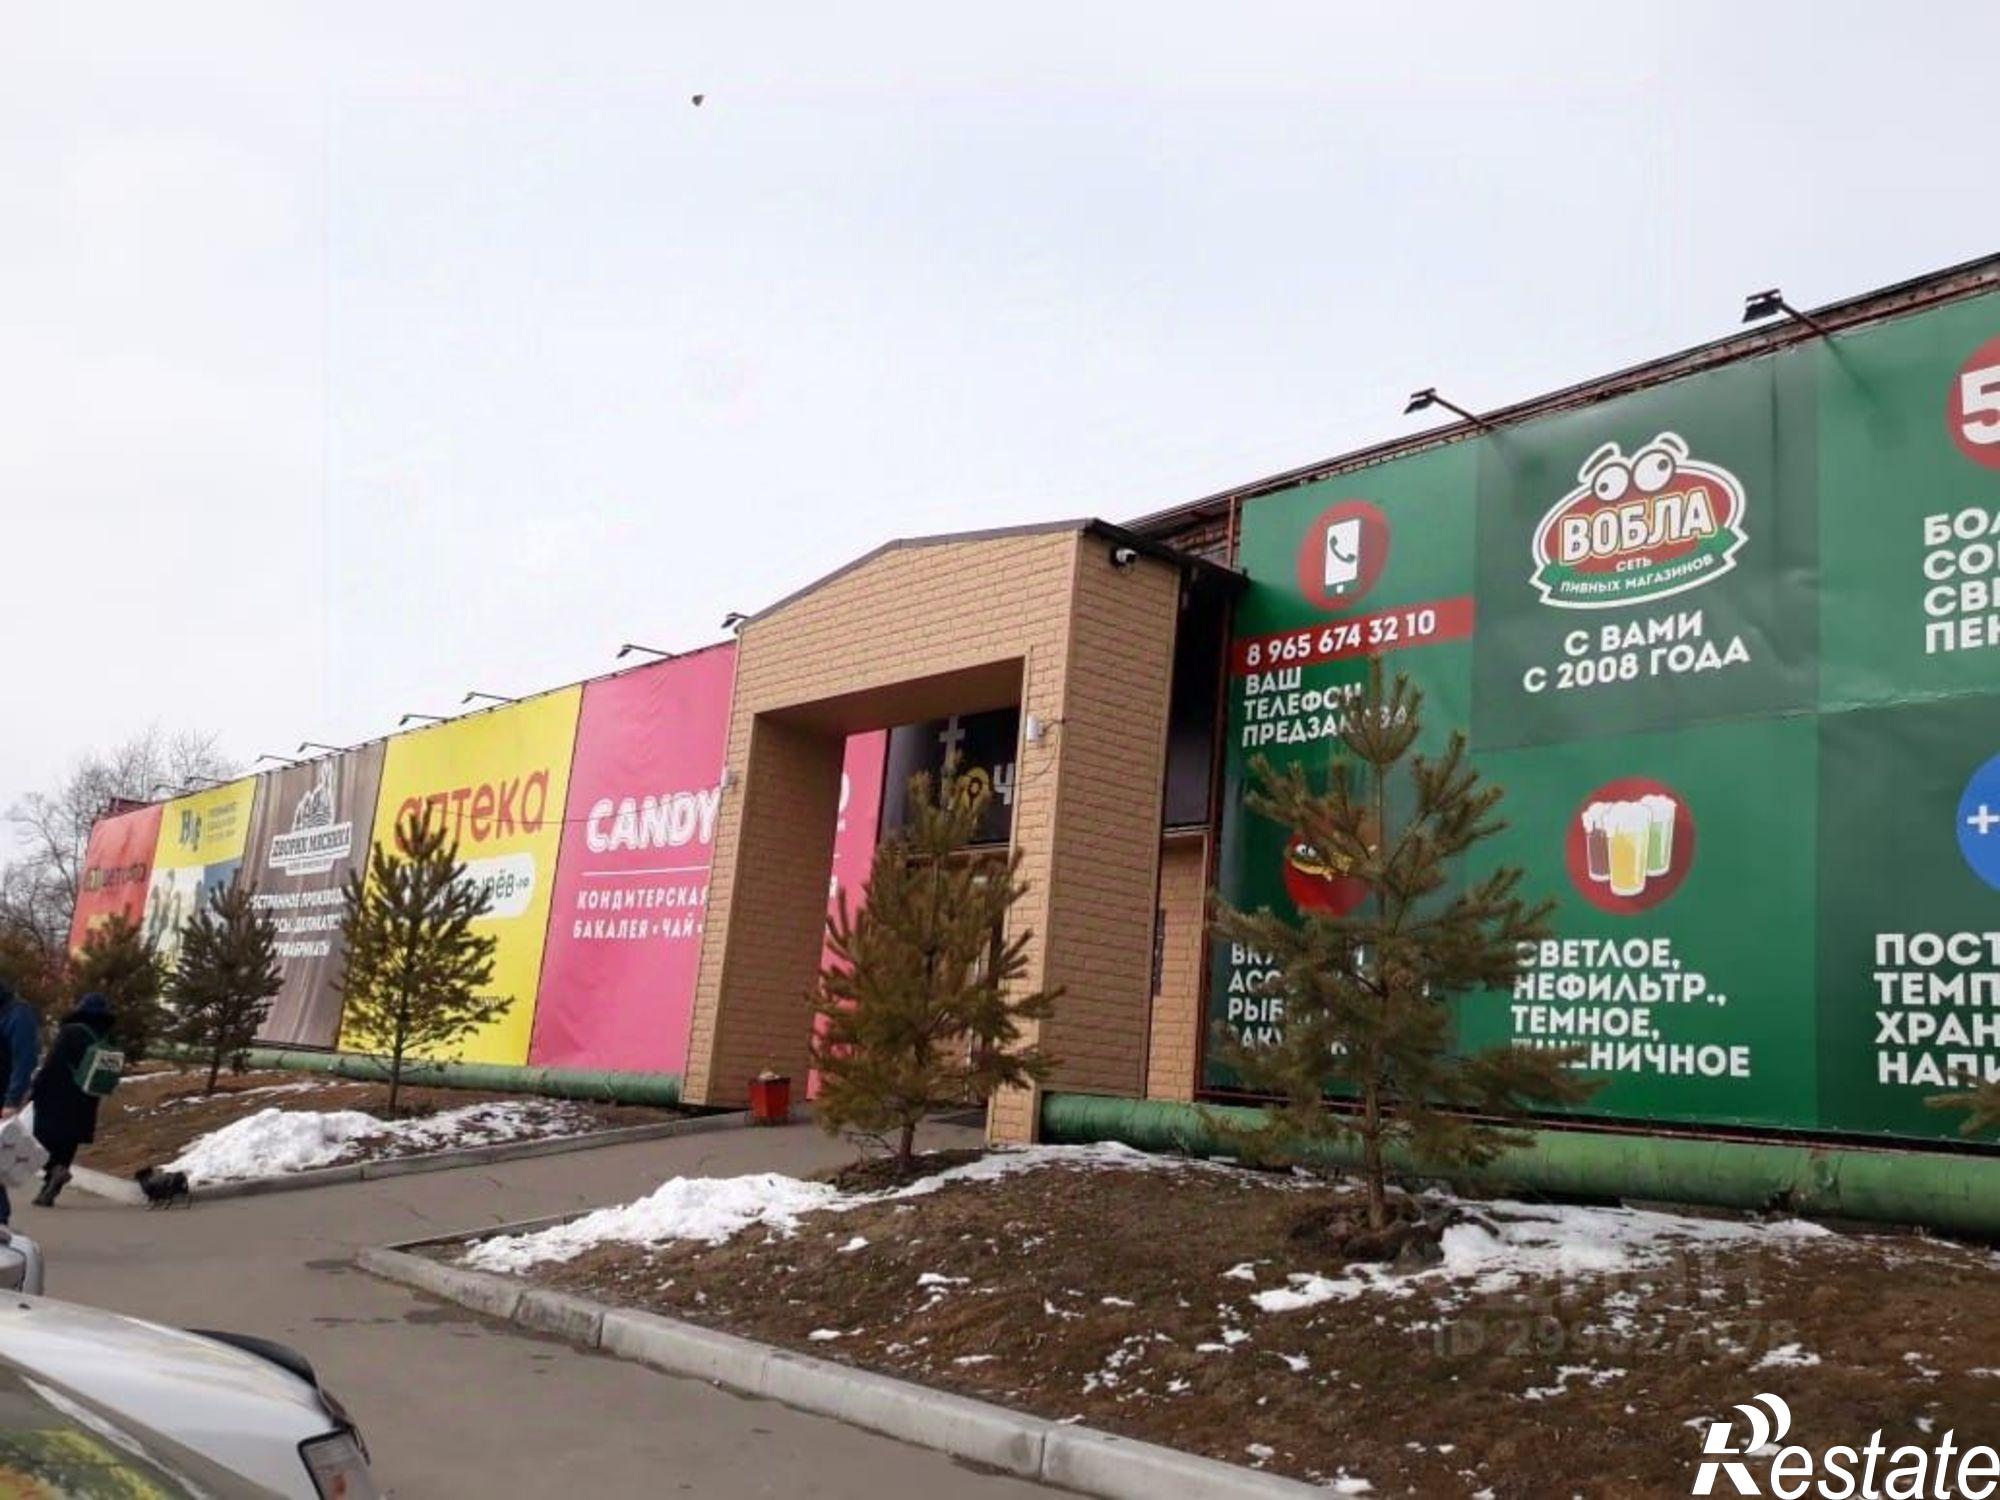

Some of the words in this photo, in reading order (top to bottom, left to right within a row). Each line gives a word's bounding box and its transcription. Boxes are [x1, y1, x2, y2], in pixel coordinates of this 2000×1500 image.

[1561, 489, 1716, 564] ВОБЛА
[1560, 576, 1621, 593] ПИВНЫХ
[1625, 552, 1714, 590] МАГАЗИНОВ
[1616, 557, 1652, 573] СЕТЬ
[1923, 540, 2000, 580] СО
[1246, 644, 1261, 666] 8
[1268, 634, 1311, 663] 965
[1318, 624, 1361, 654] 674
[1368, 616, 1398, 644] 32
[1406, 610, 1435, 637] 10
[1564, 630, 1589, 656] С
[1601, 609, 1703, 652] ВАМИ
[1246, 667, 1301, 695] ВАШ
[1523, 666, 1547, 692] С
[1557, 653, 1639, 689] 2008
[1650, 635, 1750, 675] ГОДА
[394, 769, 548, 855] аптека
[586, 787, 721, 853] CANDY
[573, 919, 648, 939] БАКАЛЕЯ
[662, 912, 694, 938] ЧАЙ
[1516, 938, 1681, 970] СВЕТЛОЕ,
[1513, 973, 1727, 1006] НЕФИЛЬТР.,
[1873, 972, 2000, 1006] ТЕМП
[1511, 1005, 1660, 1041] ТЕМНОЕ,
[1874, 1011, 2000, 1047] ХРАН
[1511, 1038, 1751, 1077] НИЧНОЕ
